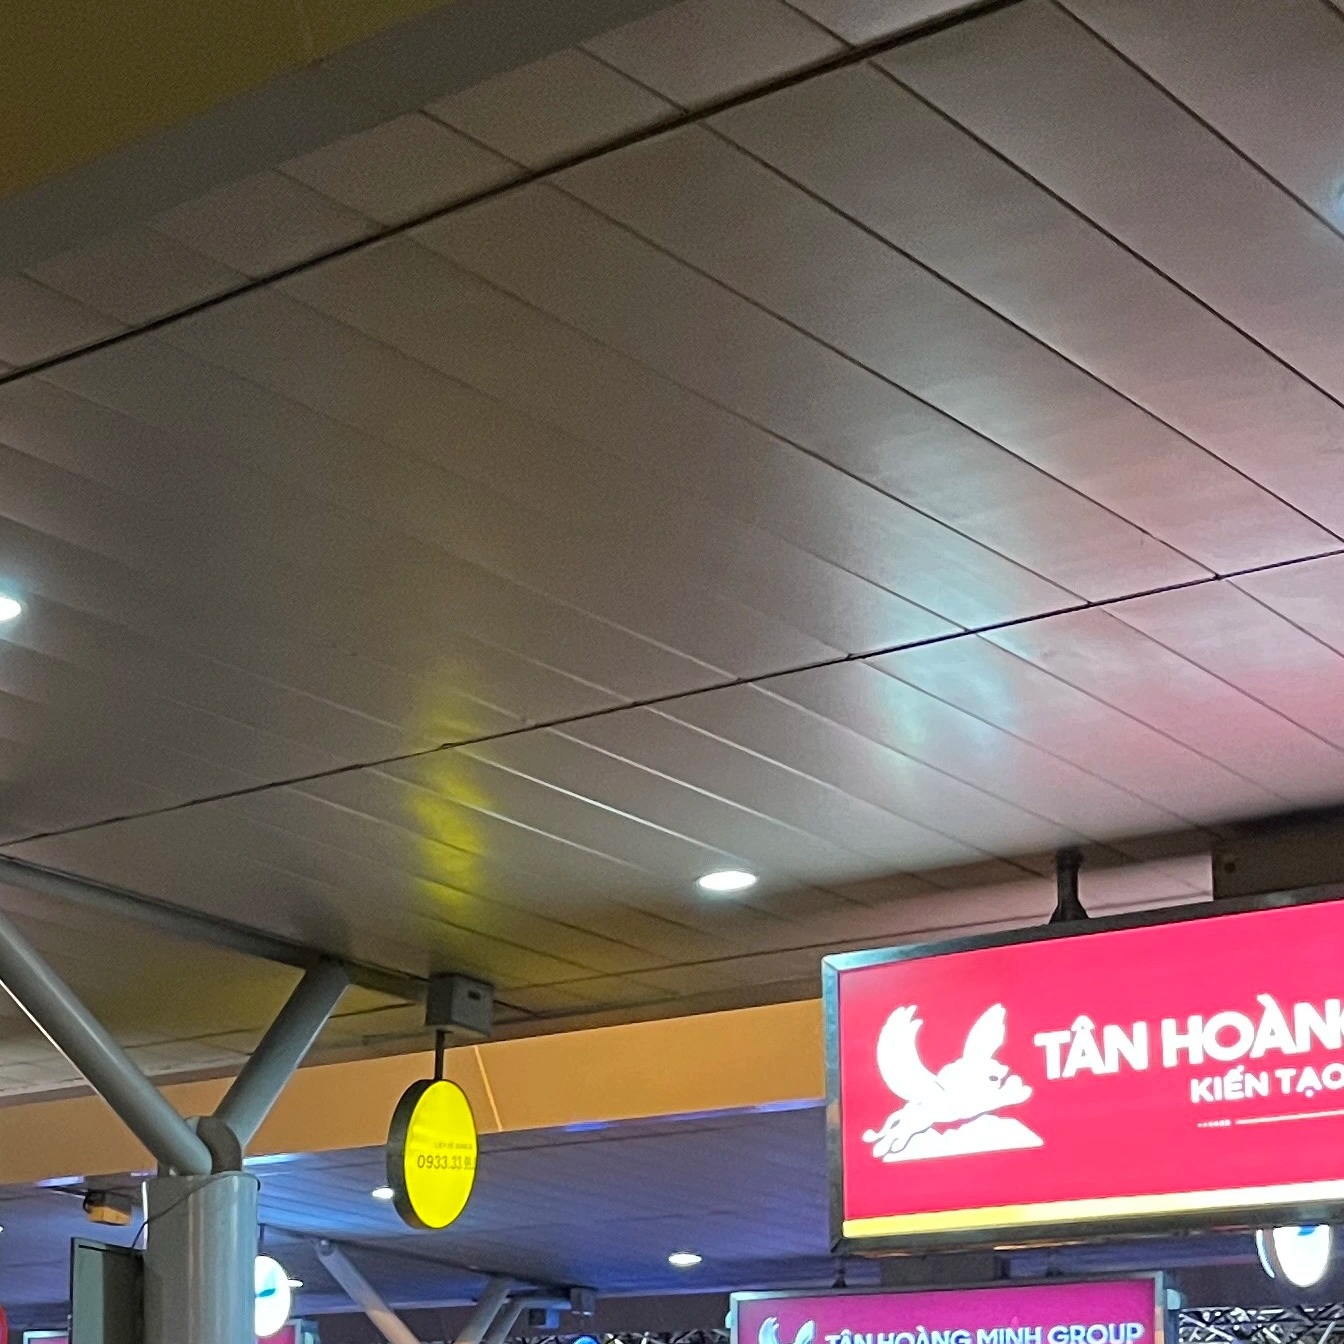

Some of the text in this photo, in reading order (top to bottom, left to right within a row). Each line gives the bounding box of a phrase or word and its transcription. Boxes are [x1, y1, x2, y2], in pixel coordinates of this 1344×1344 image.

[1034, 993, 1344, 1081] TÂN HOÀN
[1191, 1064, 1269, 1104] KIẾN
